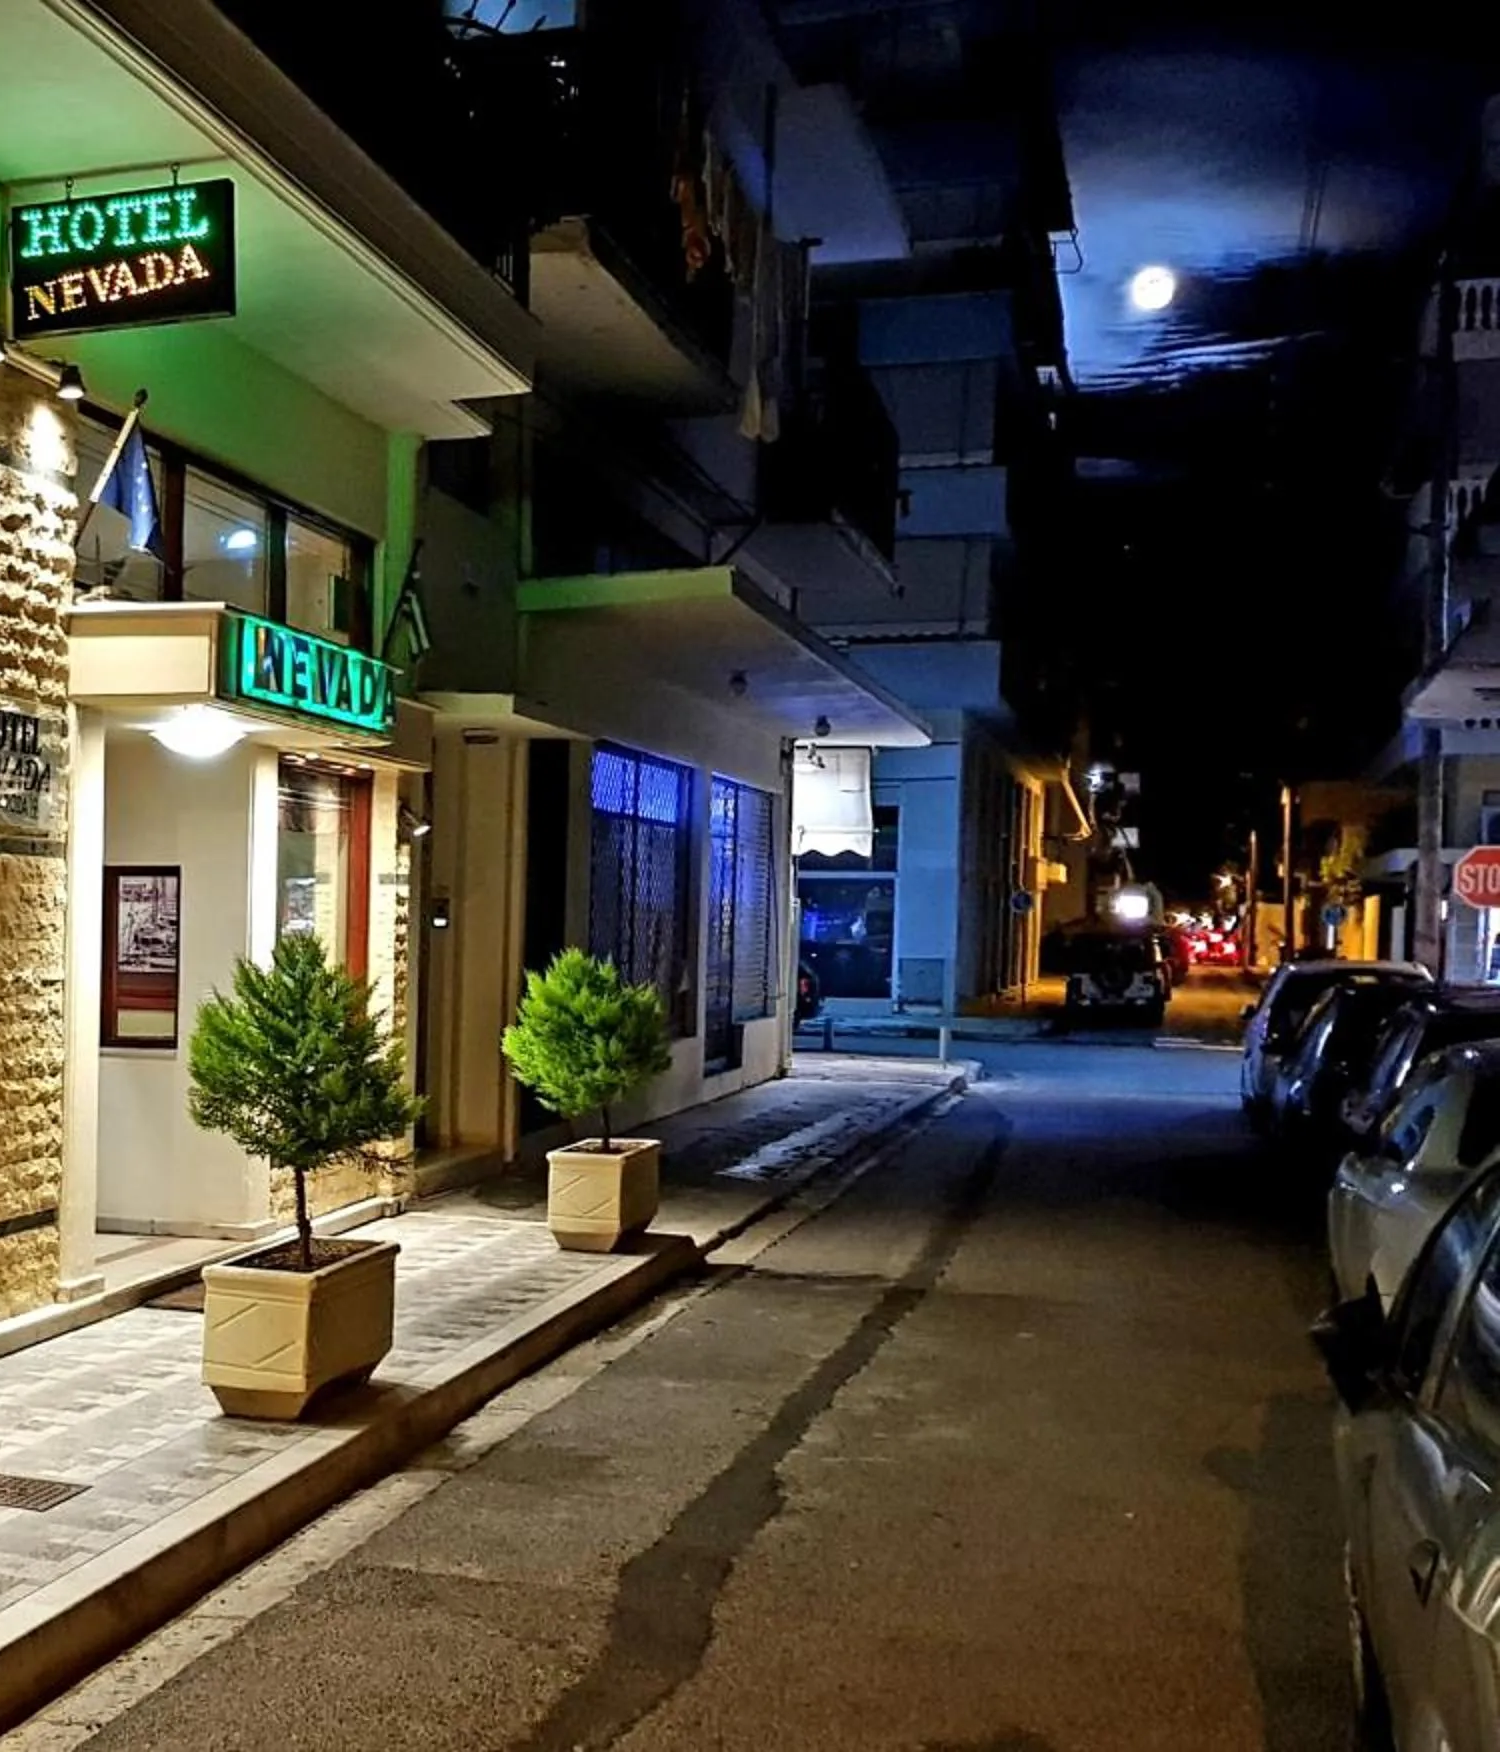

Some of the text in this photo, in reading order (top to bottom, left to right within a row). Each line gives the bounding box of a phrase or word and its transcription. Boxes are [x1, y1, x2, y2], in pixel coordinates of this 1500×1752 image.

[20, 188, 209, 259] HOTEL
[24, 242, 210, 321] NEVADA
[255, 626, 397, 727] NEVADA
[1459, 863, 1500, 895] STO
